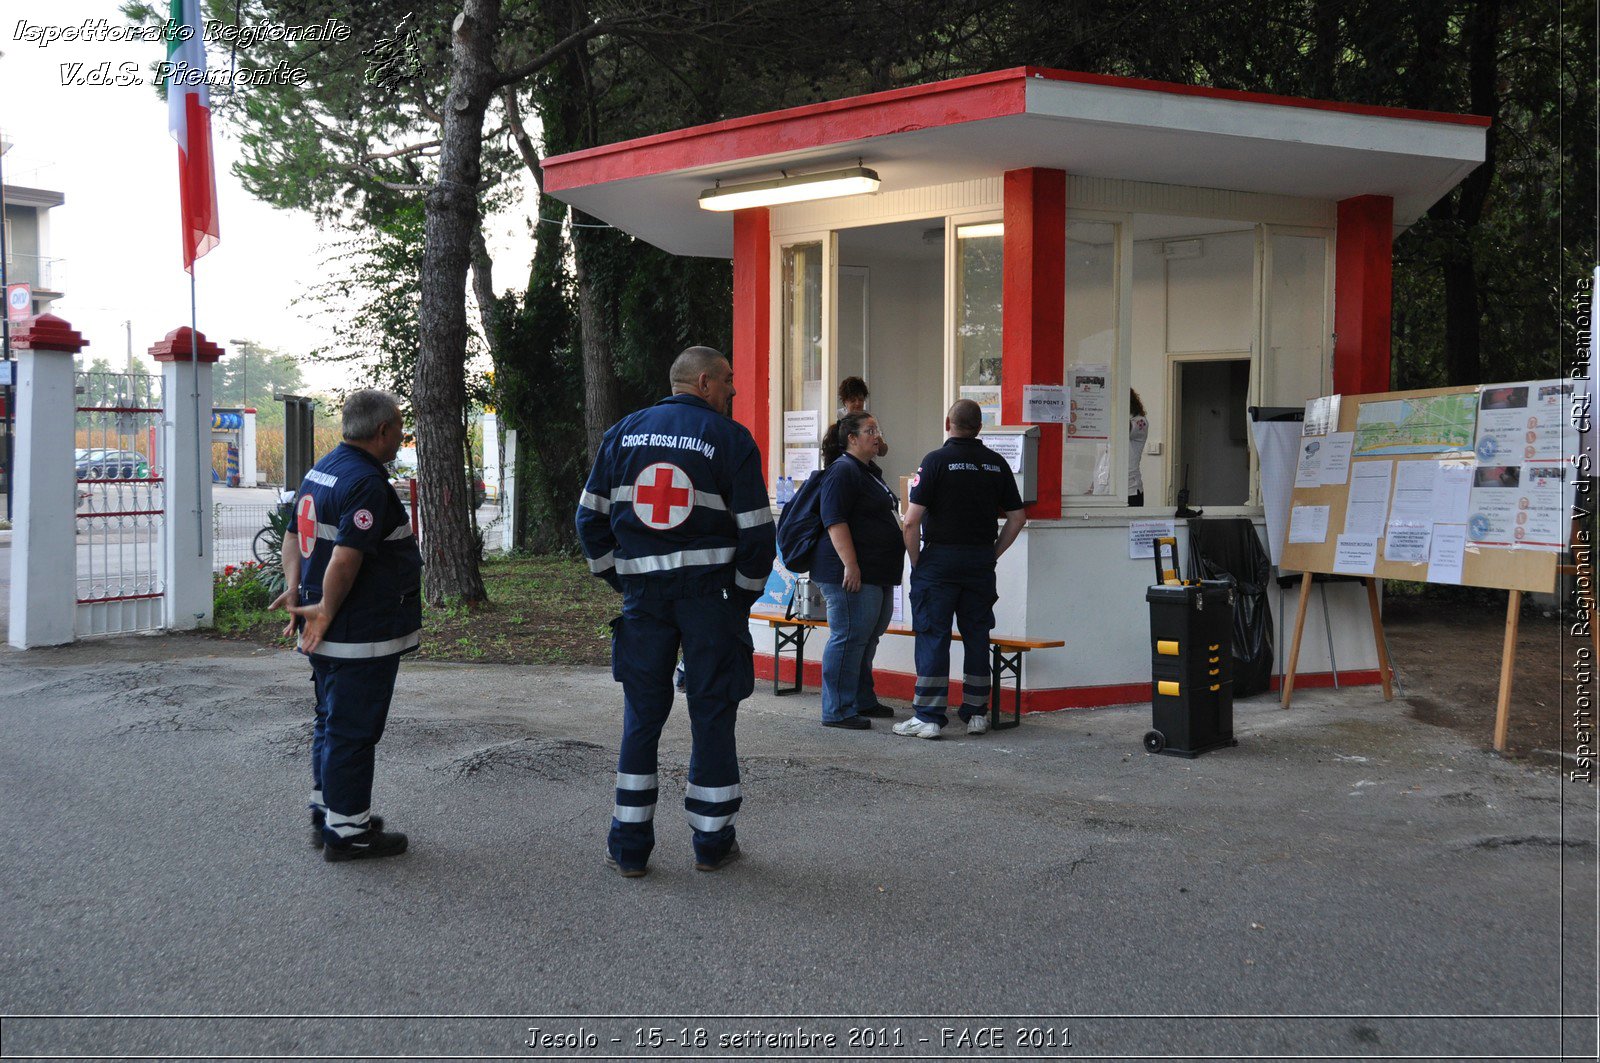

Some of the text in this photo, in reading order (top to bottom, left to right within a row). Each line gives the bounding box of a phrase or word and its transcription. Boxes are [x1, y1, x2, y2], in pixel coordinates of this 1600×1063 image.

[621, 433, 716, 460] CROCE ROSSA ITALIANA
[948, 463, 965, 471] CROCE
